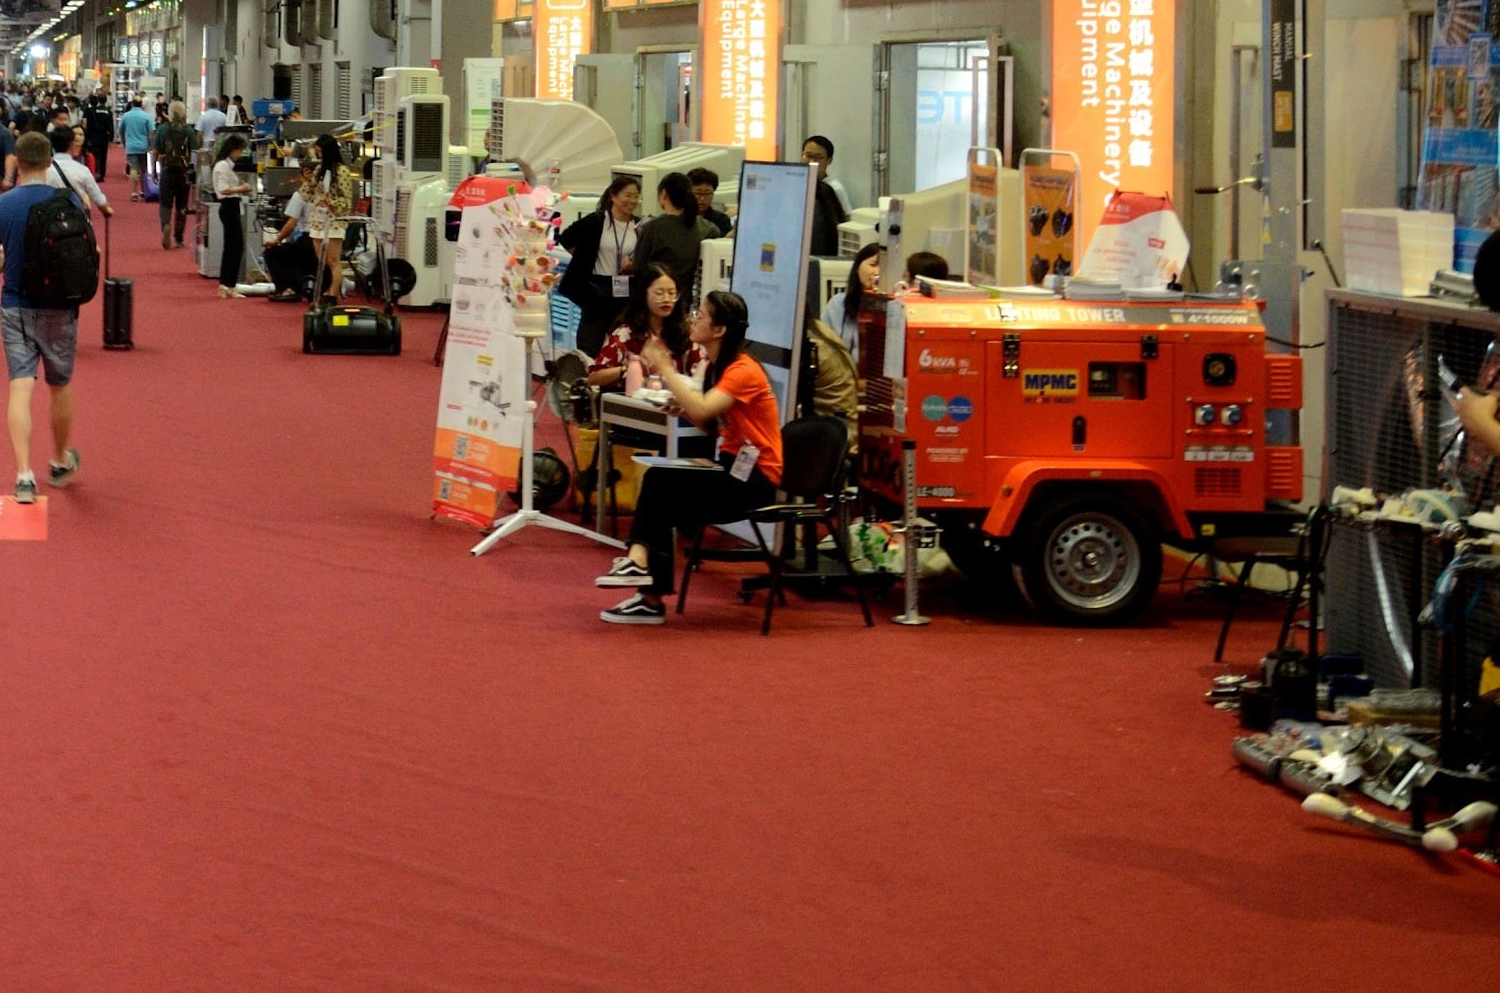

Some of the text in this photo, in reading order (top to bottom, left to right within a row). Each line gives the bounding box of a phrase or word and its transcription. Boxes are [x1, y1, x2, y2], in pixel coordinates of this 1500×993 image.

[731, 0, 749, 50] Large
[1284, 21, 1293, 62] MANUAL
[547, 16, 560, 94] Equipment
[719, 0, 735, 99] Equipment
[1272, 55, 1282, 81] MAST
[1098, 46, 1126, 189] Machinery
[1068, 307, 1126, 323] TOWER
[1024, 374, 1077, 390] MPMC
